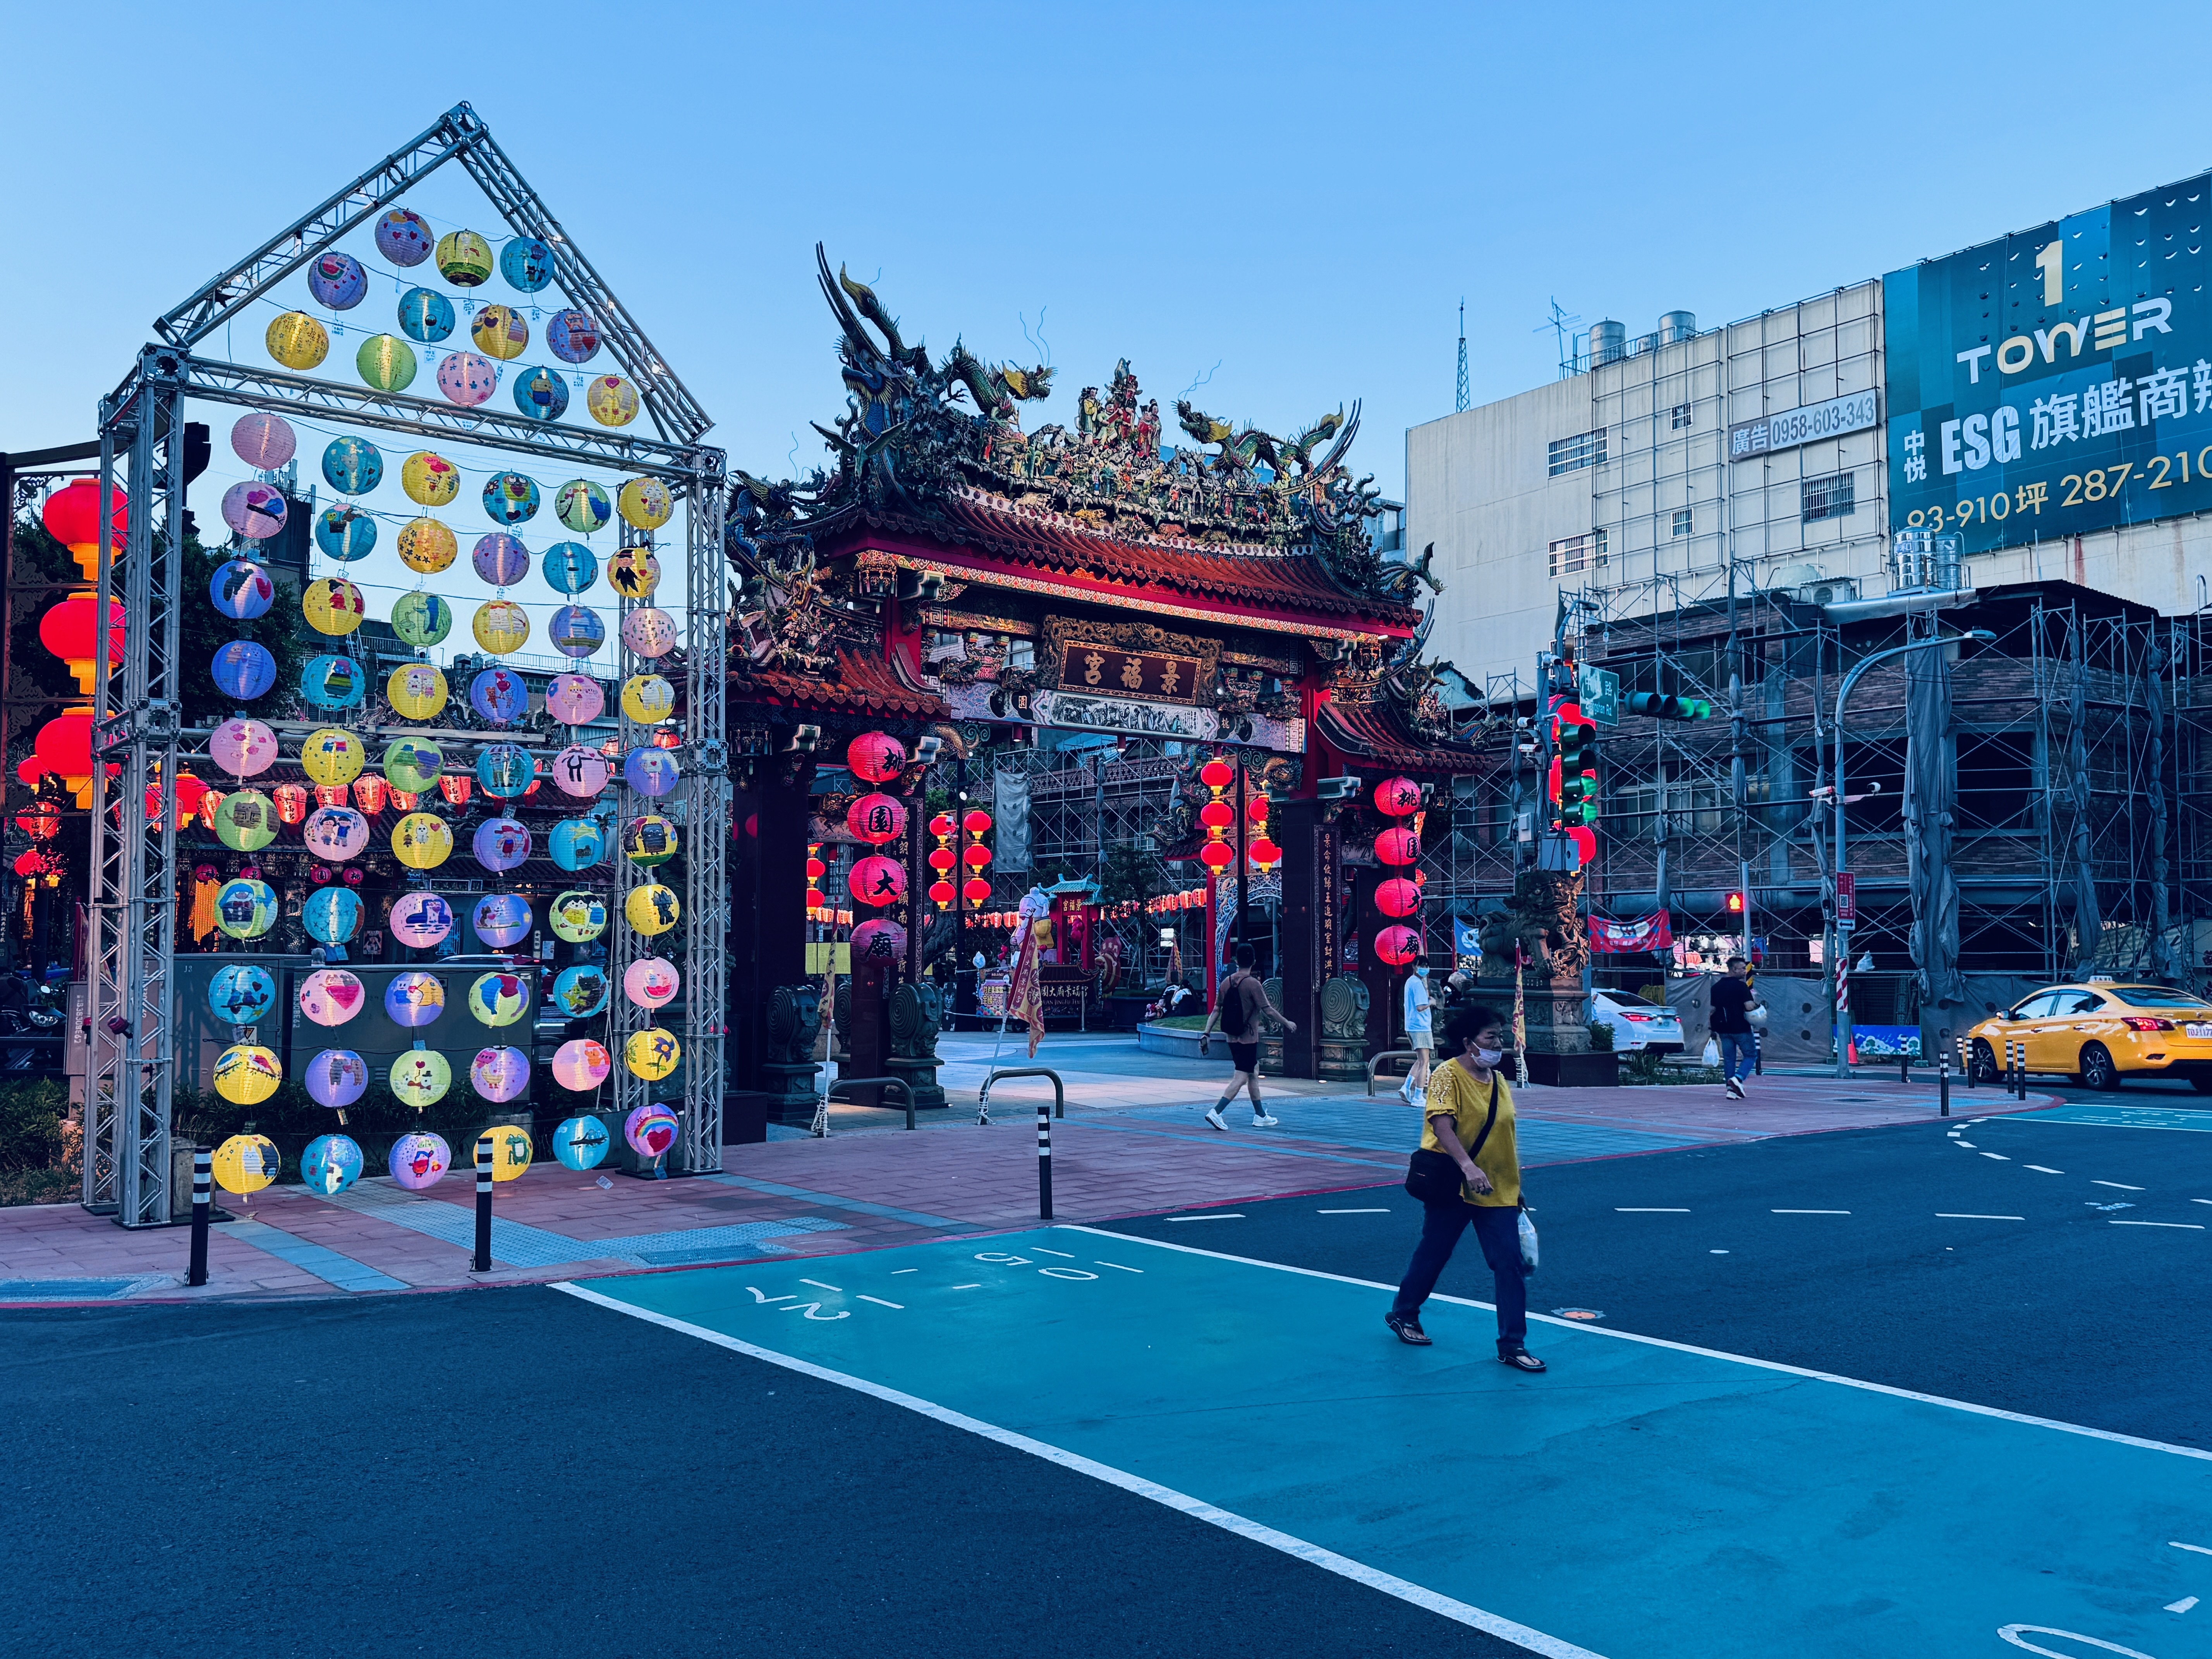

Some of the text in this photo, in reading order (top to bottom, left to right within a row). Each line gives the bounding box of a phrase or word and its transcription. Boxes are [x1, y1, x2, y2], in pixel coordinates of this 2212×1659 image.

[2036, 240, 2063, 307] 1
[1957, 297, 2173, 384] TOWER
[1732, 397, 1874, 455] 廣告 0958-603-343
[1941, 405, 2021, 475] ESG
[1084, 651, 1181, 695] 景福宮
[1585, 676, 1612, 696] 中路
[1063, 899, 1081, 911] 景福宮
